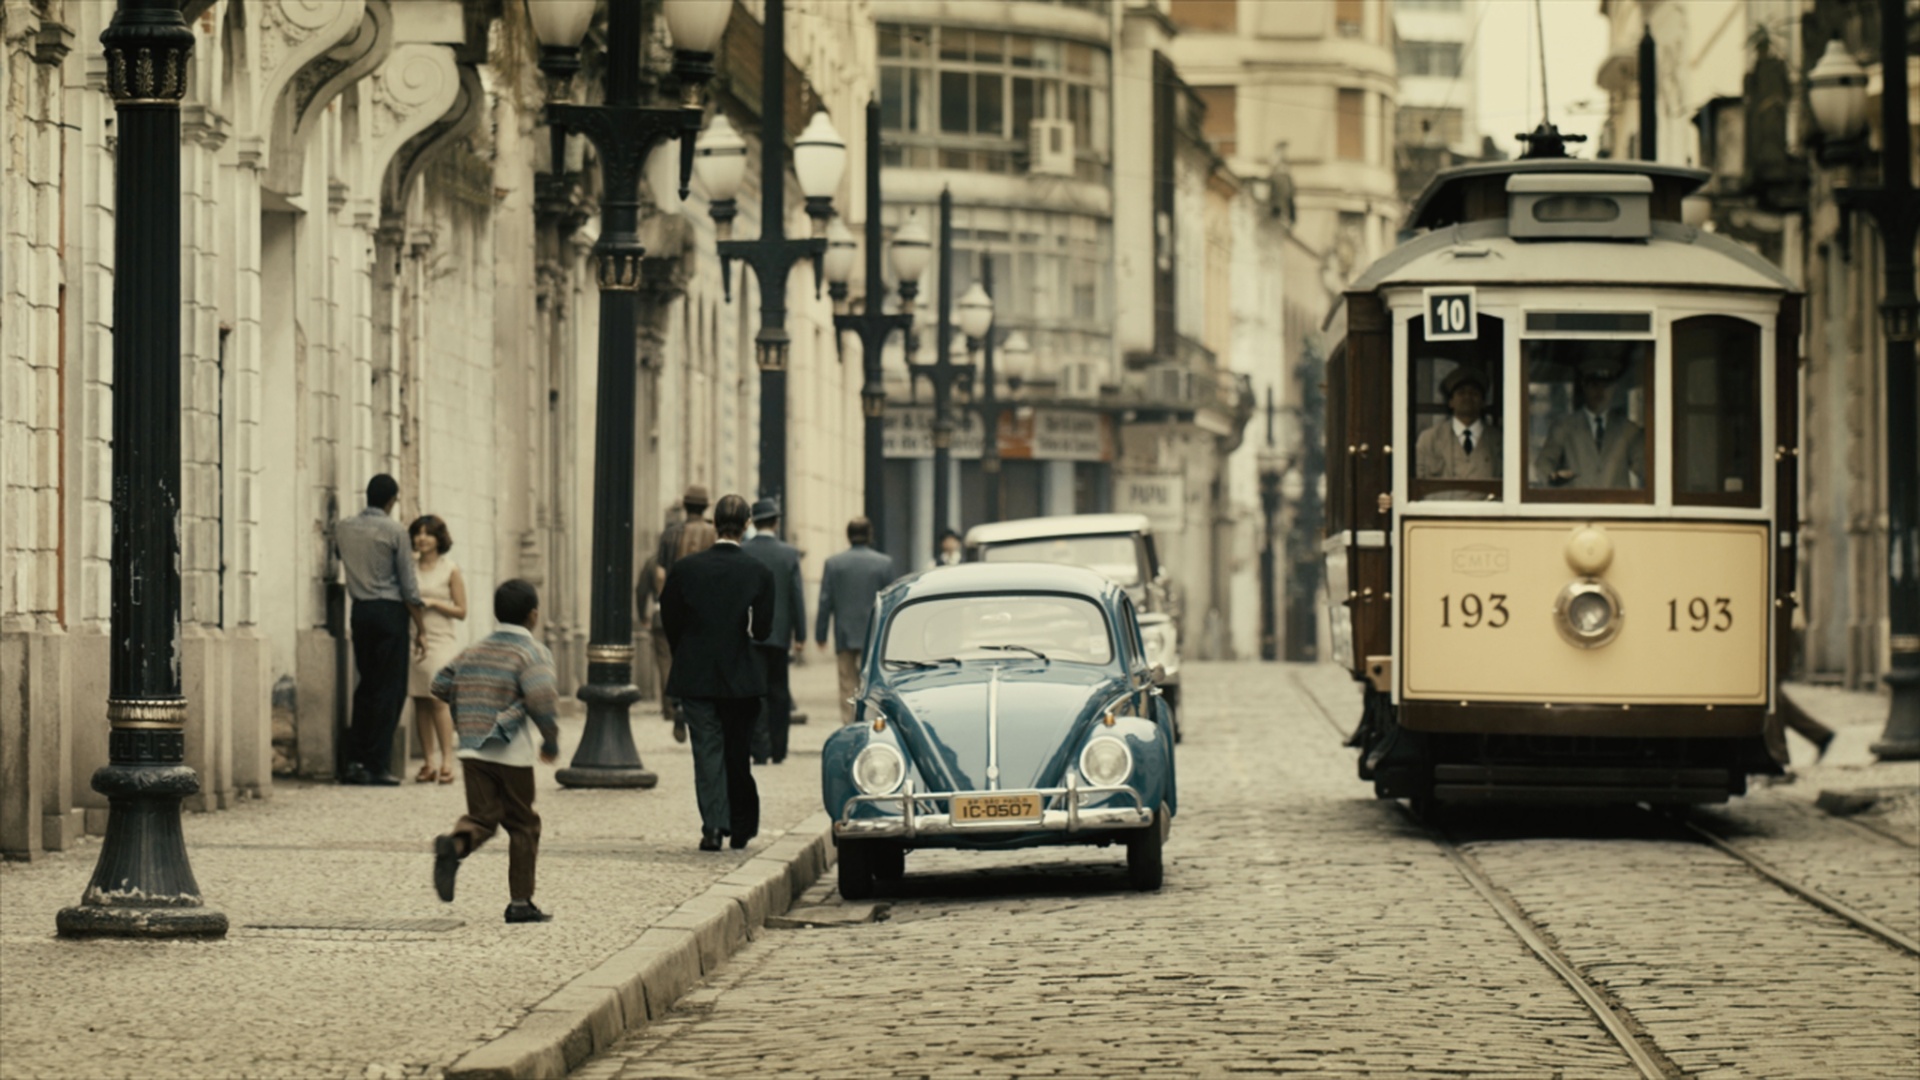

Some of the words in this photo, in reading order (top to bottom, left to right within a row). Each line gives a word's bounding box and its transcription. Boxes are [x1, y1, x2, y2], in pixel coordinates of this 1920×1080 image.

[1436, 299, 1466, 331] 10
[1454, 553, 1508, 569] CMTC
[1440, 593, 1510, 628] 193
[1667, 597, 1733, 632] 193
[963, 803, 1033, 819] IC-0507
